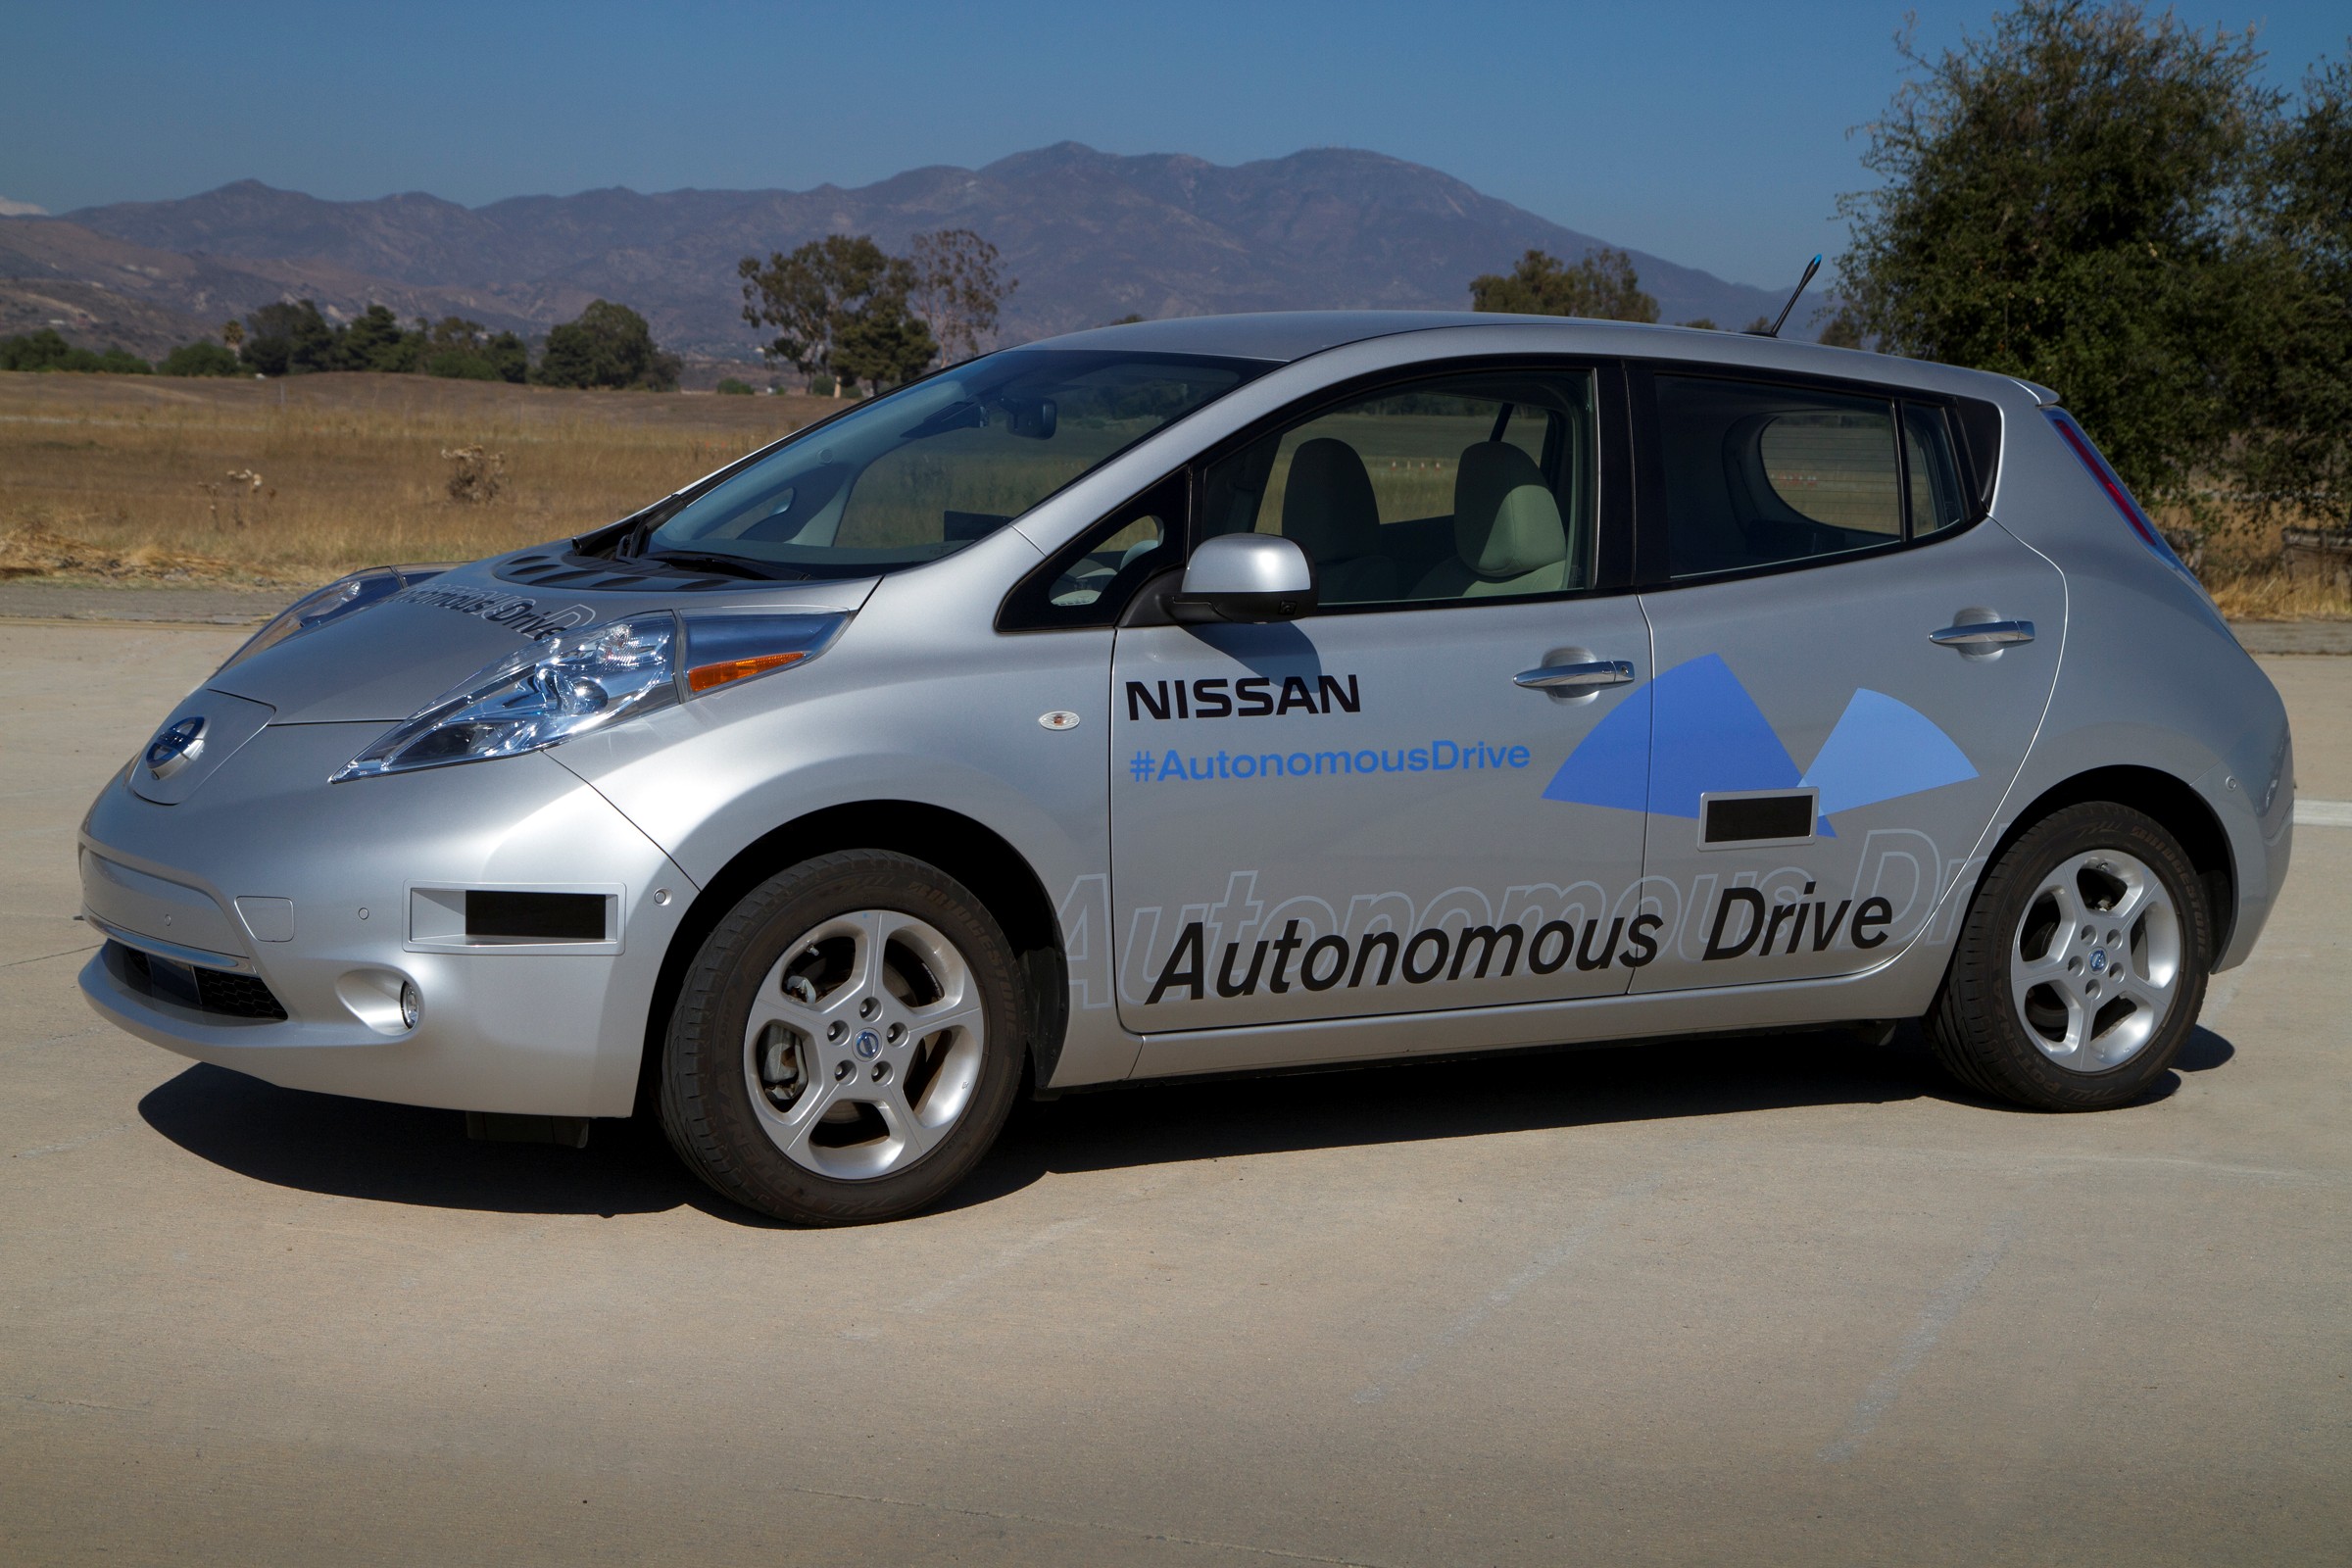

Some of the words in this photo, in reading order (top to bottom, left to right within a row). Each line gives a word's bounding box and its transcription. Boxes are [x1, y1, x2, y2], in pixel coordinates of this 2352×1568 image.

[1126, 674, 1360, 720] NISSAN
[1129, 740, 1531, 782] #AutonomousDrive
[907, 880, 1018, 1040] BRIDGESTONE
[1144, 913, 1664, 1004] Autonomous
[1702, 881, 1892, 961] Drive
